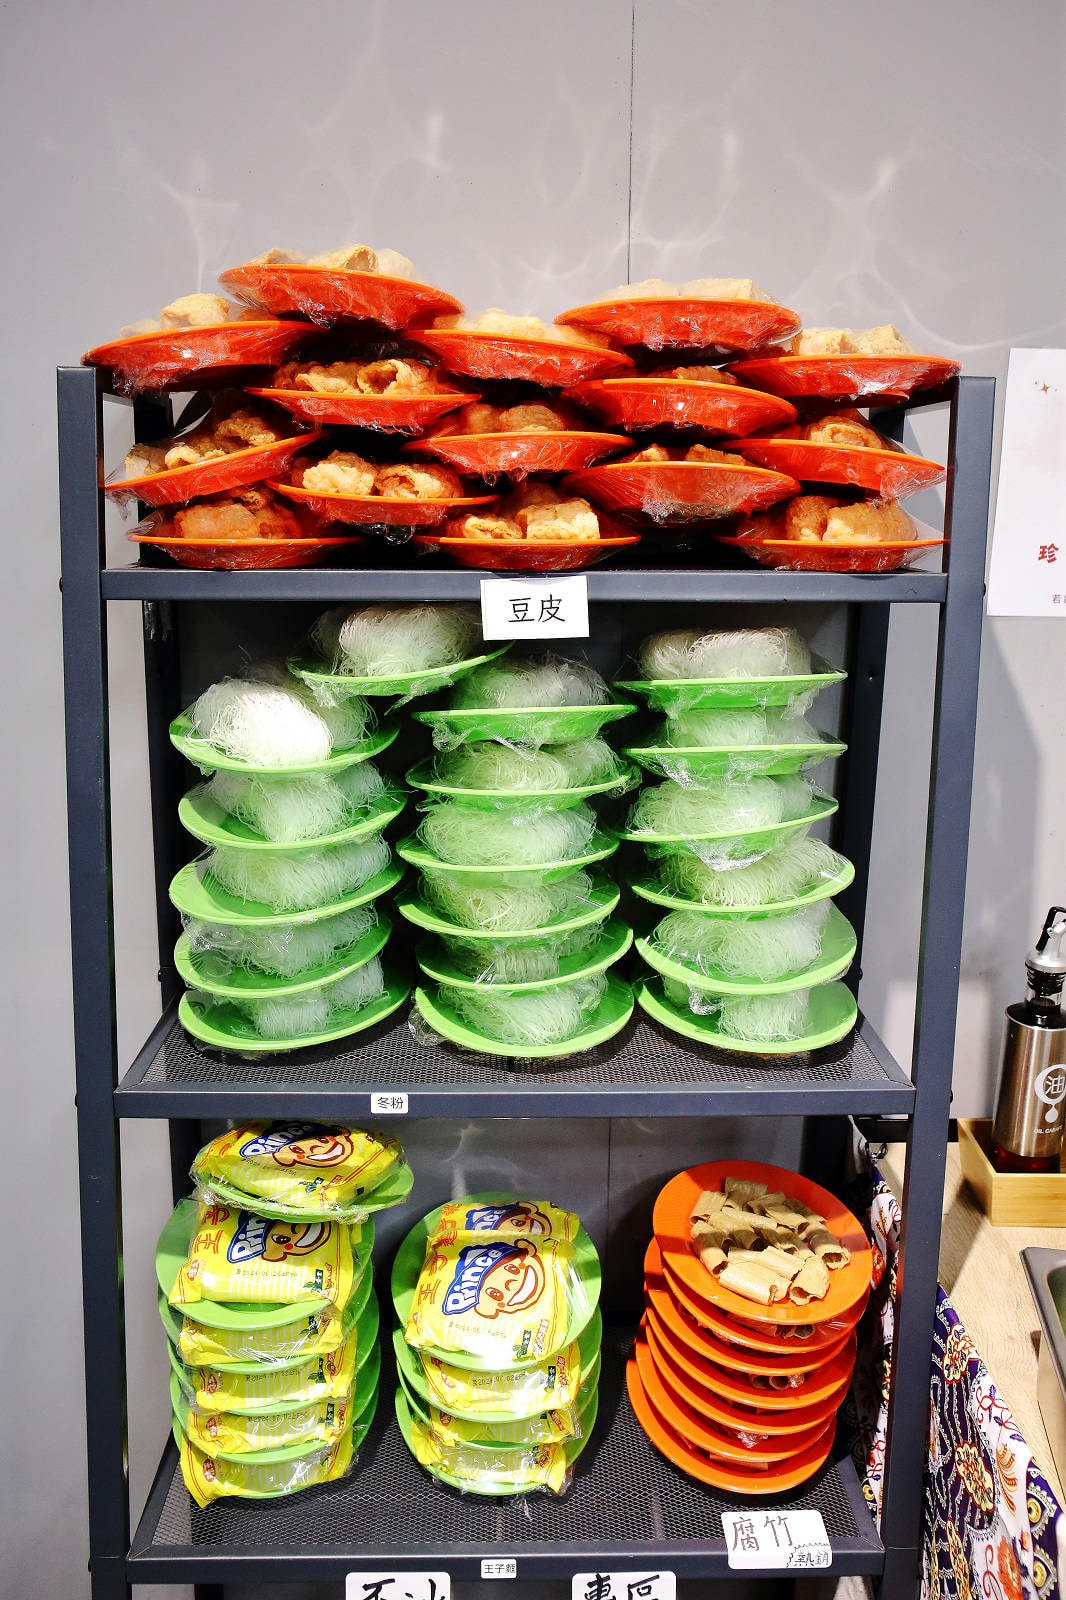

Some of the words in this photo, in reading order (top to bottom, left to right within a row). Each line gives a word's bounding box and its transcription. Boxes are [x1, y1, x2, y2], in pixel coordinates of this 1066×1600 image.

[1038, 543, 1059, 563] 珍
[508, 593, 566, 623] 豆皮
[1045, 1075, 1066, 1094] 油
[377, 1096, 404, 1109] 冬粉
[444, 1249, 503, 1313] Prince
[732, 1516, 793, 1551] 腐竹
[484, 1563, 516, 1574] 王子麵
